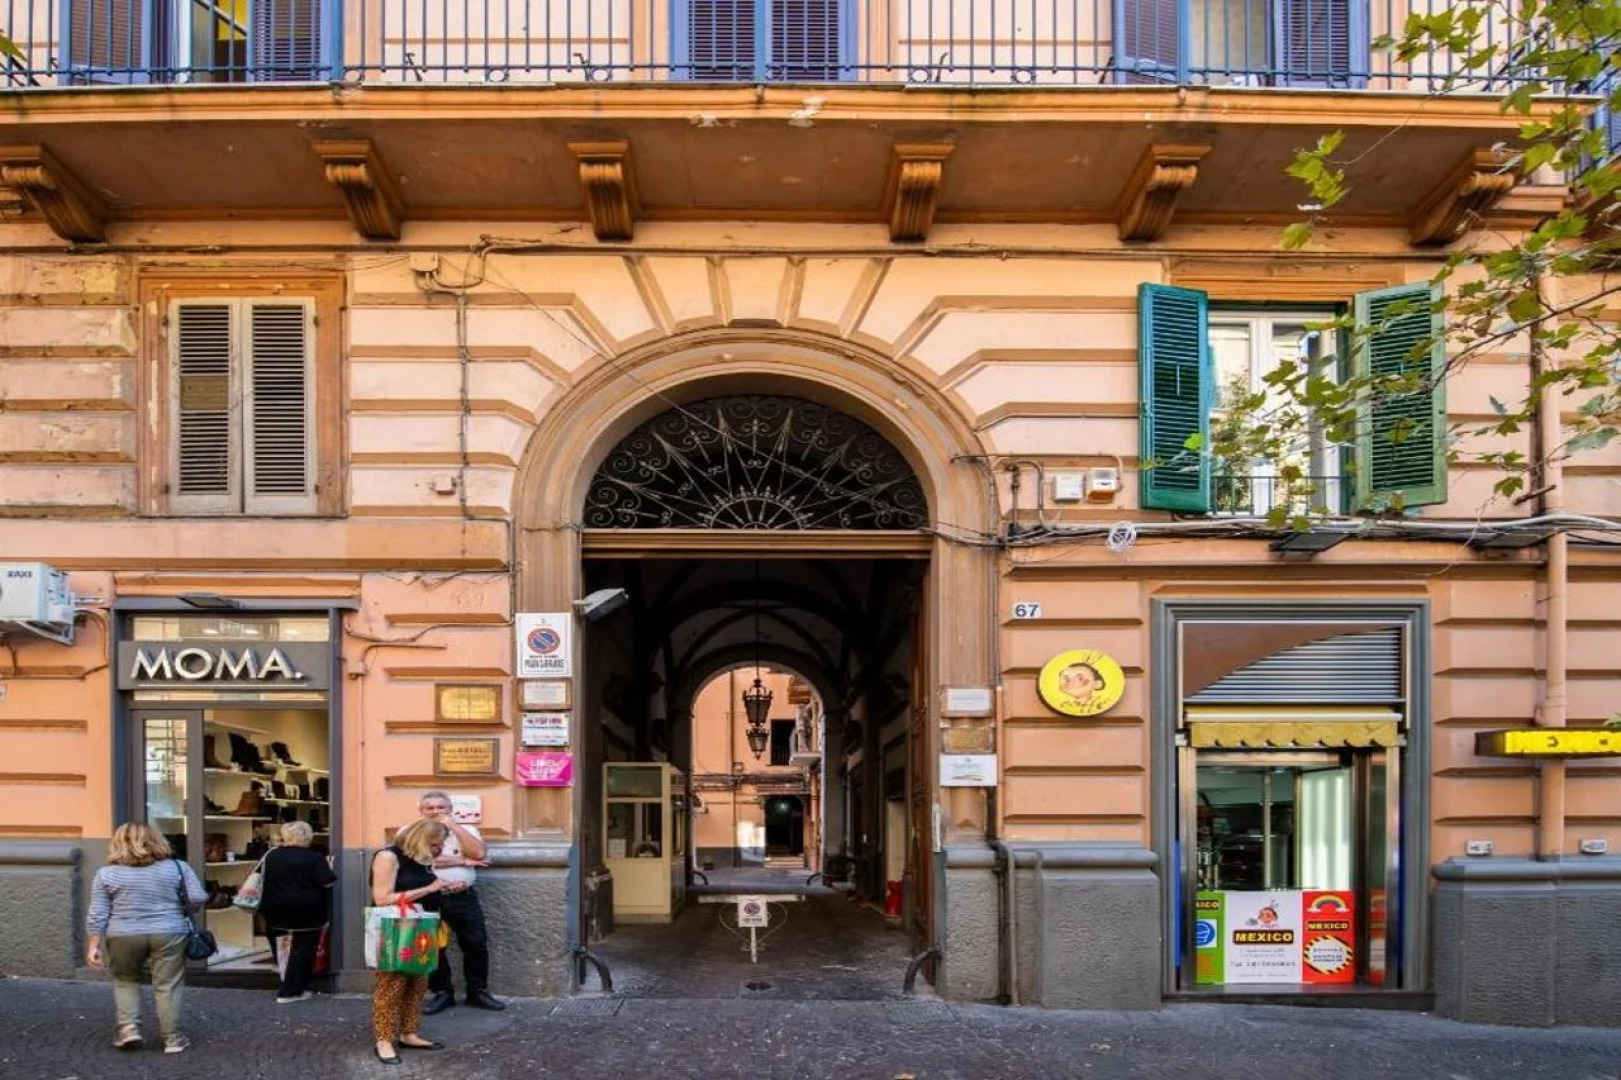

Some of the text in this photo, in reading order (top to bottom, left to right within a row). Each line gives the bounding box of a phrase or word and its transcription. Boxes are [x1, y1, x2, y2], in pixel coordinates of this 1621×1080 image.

[1014, 604, 1039, 617] 67
[130, 648, 303, 680] MOMA.
[1308, 922, 1349, 930] MEXICO
[1235, 931, 1294, 943] MEXICO
